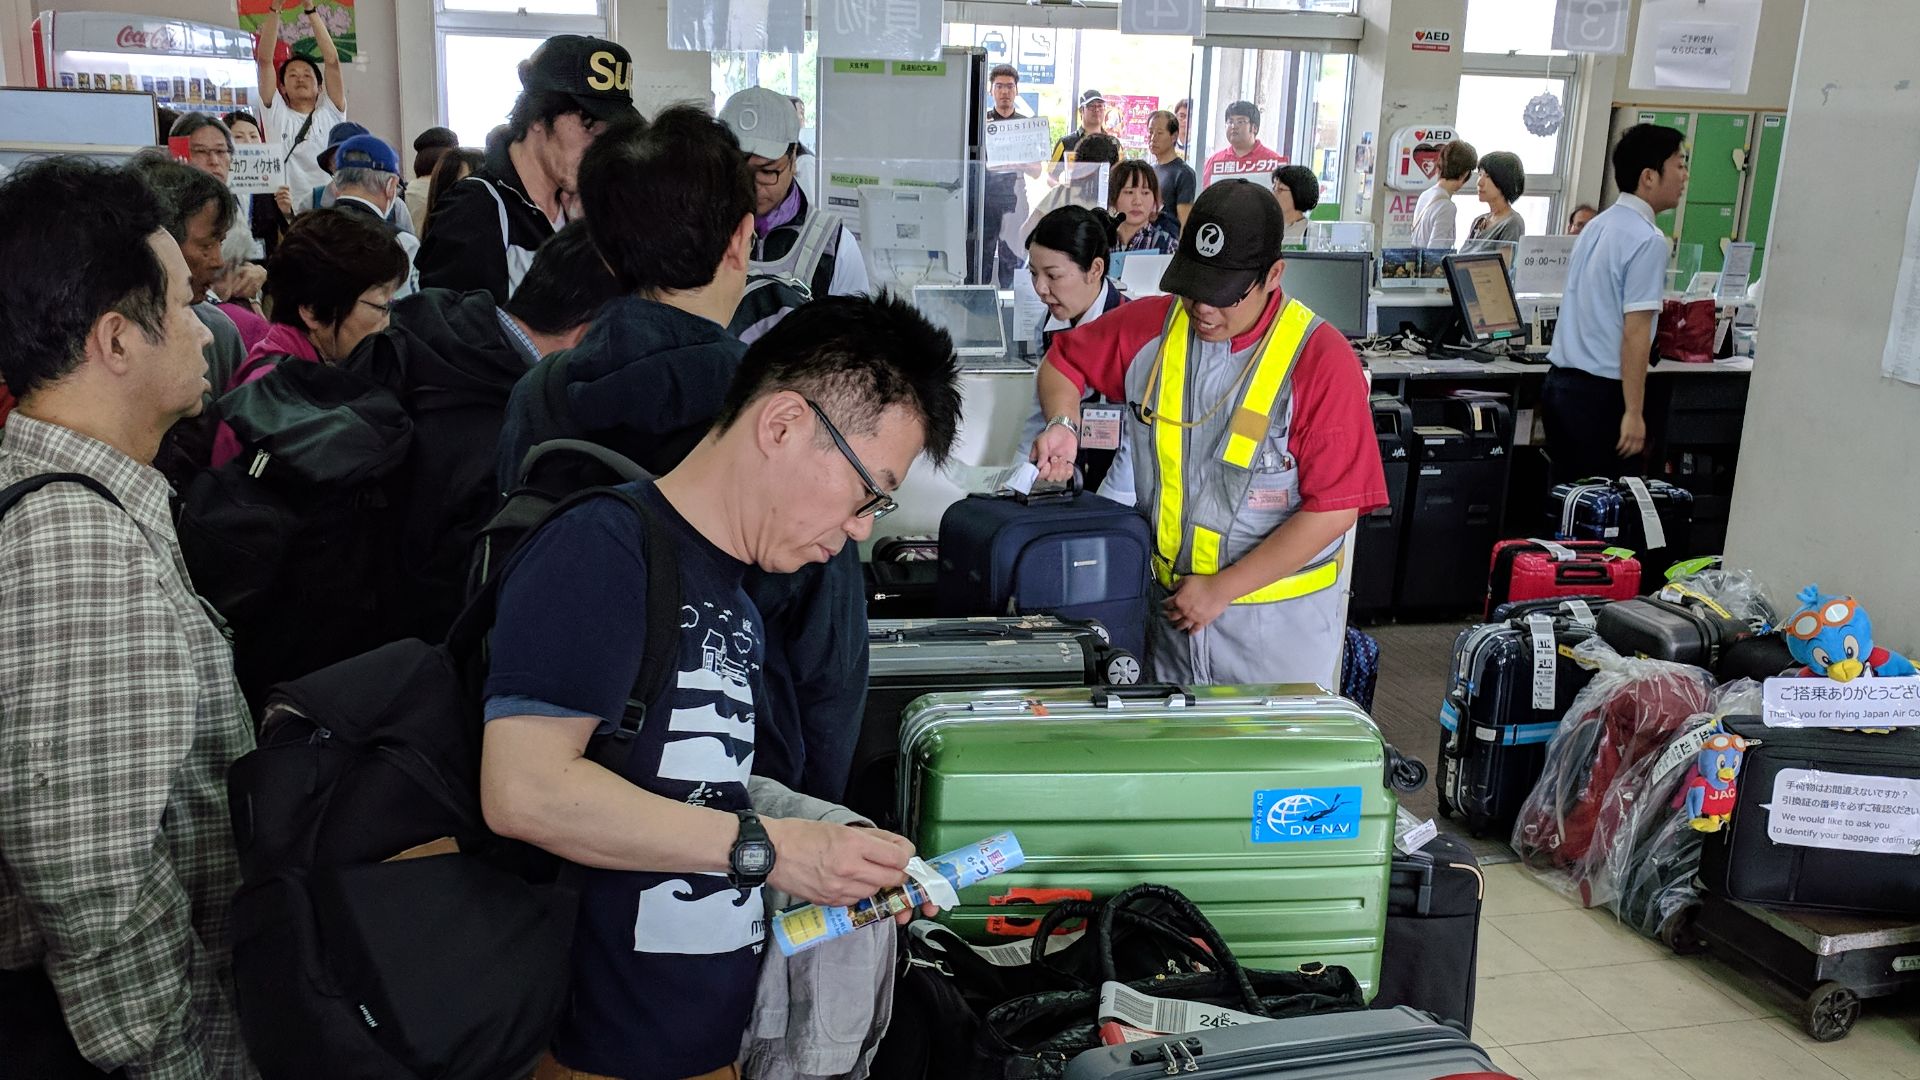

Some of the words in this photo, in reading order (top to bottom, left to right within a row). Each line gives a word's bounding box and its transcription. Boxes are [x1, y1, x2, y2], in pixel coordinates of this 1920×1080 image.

[1425, 31, 1450, 41] AED
[1425, 131, 1452, 141] AED
[1213, 159, 1288, 174] 日産レンタカー
[1389, 195, 1419, 214] AE
[1200, 246, 1215, 254] JAL
[1799, 713, 1816, 721] you
[1819, 709, 1832, 718] for
[1835, 709, 1860, 720] flying
[1862, 709, 1890, 721] Japan
[1893, 709, 1906, 718] Air
[1709, 788, 1736, 800] JAC
[1781, 812, 1796, 822] We
[1798, 815, 1825, 824] would
[1828, 817, 1843, 826] like
[1845, 819, 1854, 827] to
[1856, 820, 1871, 828] ask
[1874, 822, 1890, 831] you
[1773, 826, 1782, 834] to
[1784, 827, 1818, 838] identify
[1820, 831, 1840, 840] your
[1842, 833, 1880, 843] baggage
[1882, 836, 1905, 845] claim
[360, 1004, 378, 1027] Nikon
